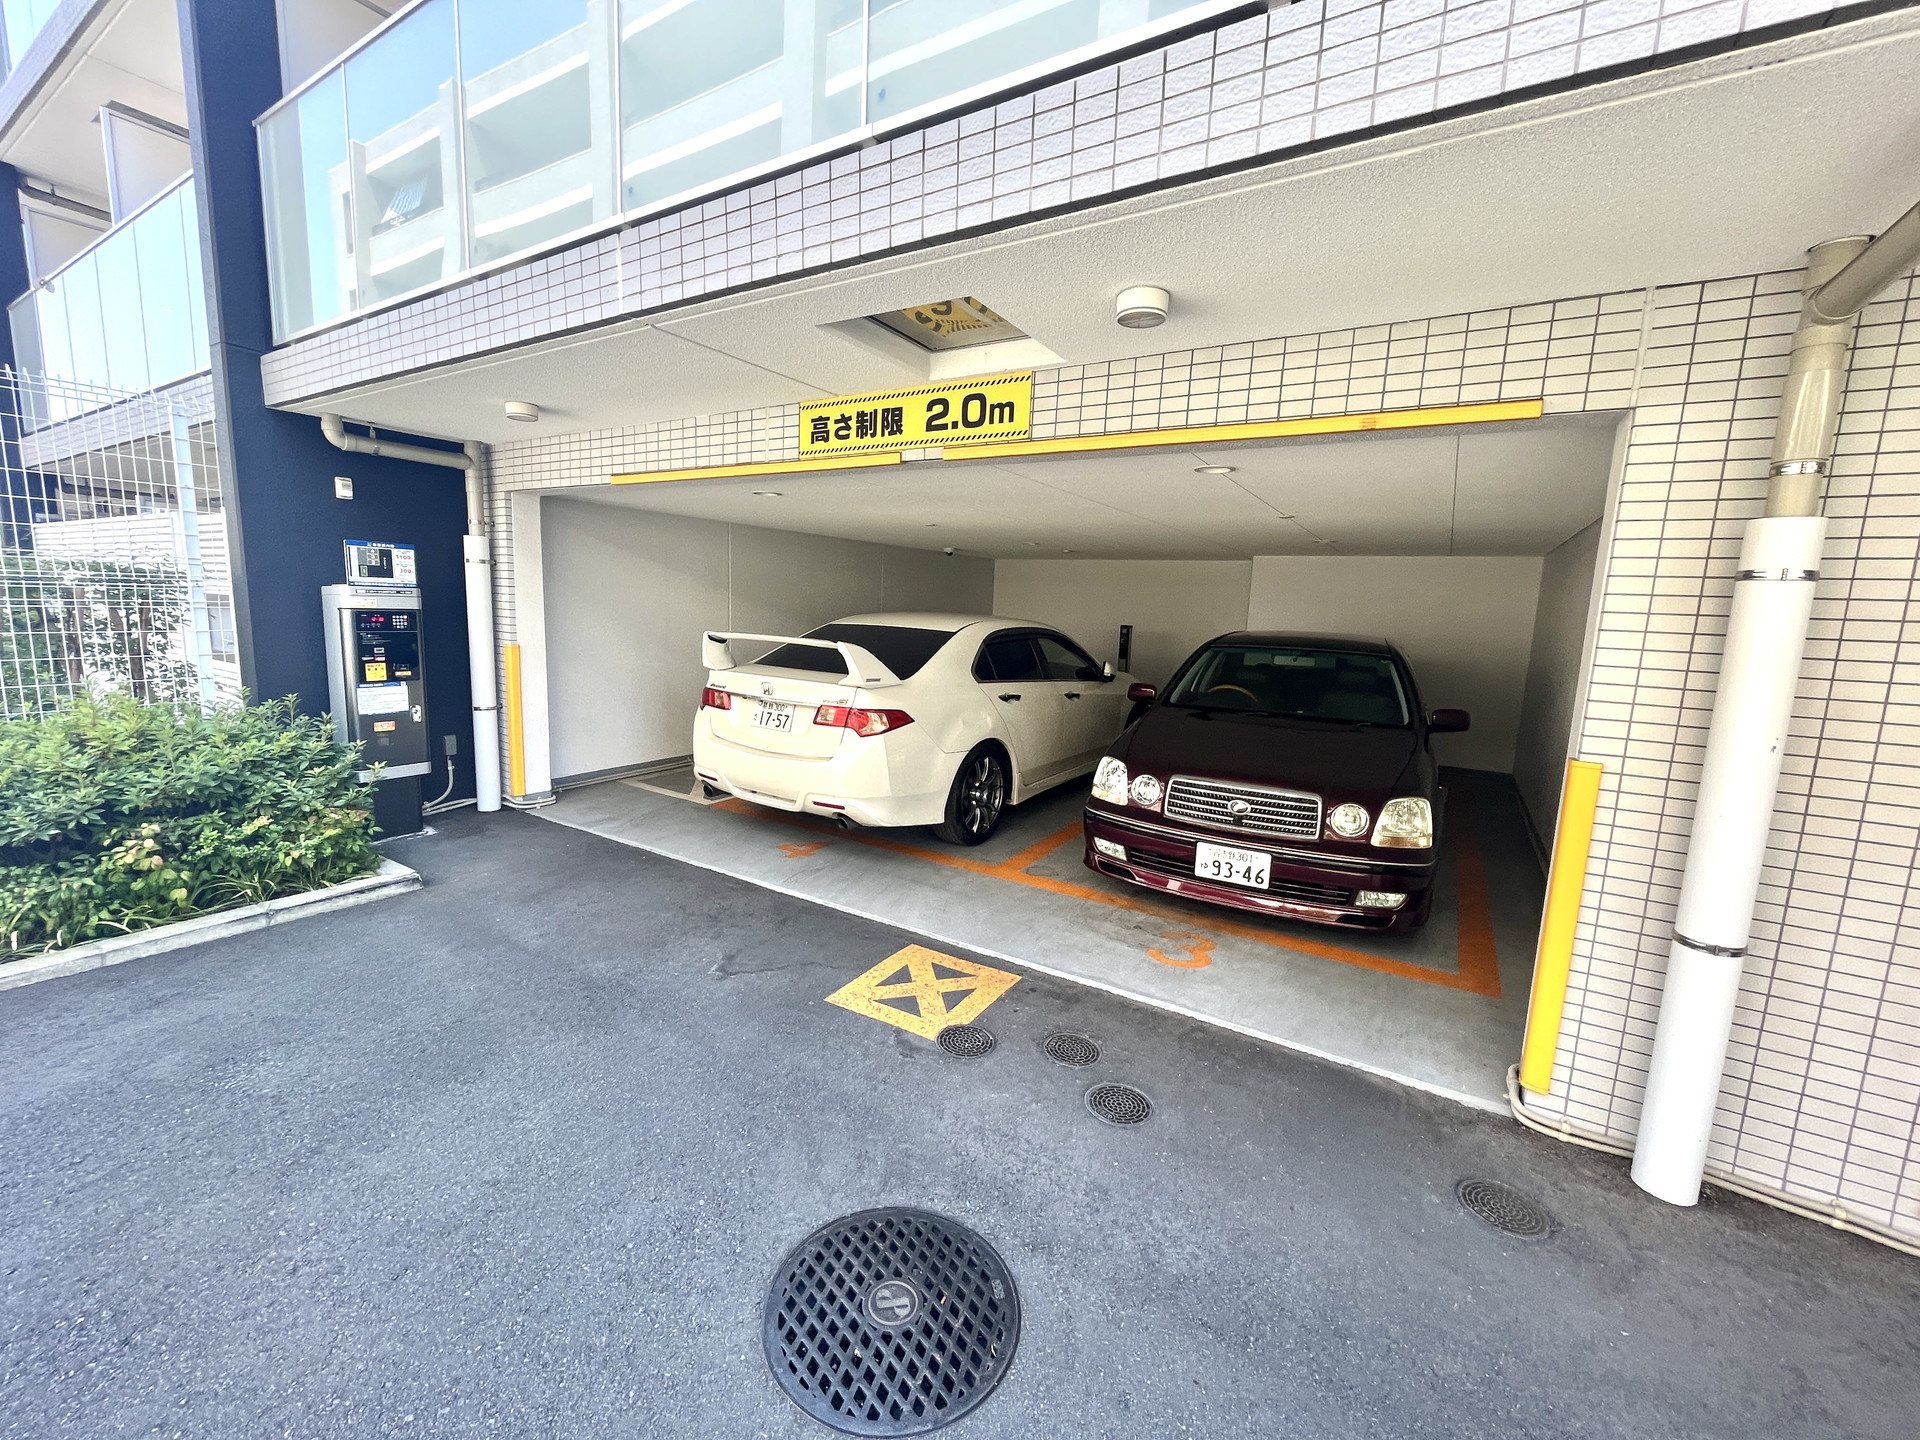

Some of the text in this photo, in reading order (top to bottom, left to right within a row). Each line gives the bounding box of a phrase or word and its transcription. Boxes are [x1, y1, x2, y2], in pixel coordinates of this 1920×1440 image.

[810, 392, 1015, 445] 高さ制限 2.0m
[759, 711, 790, 729] 17-57
[1211, 859, 1265, 885] 93-46
[1145, 931, 1217, 969] 3
